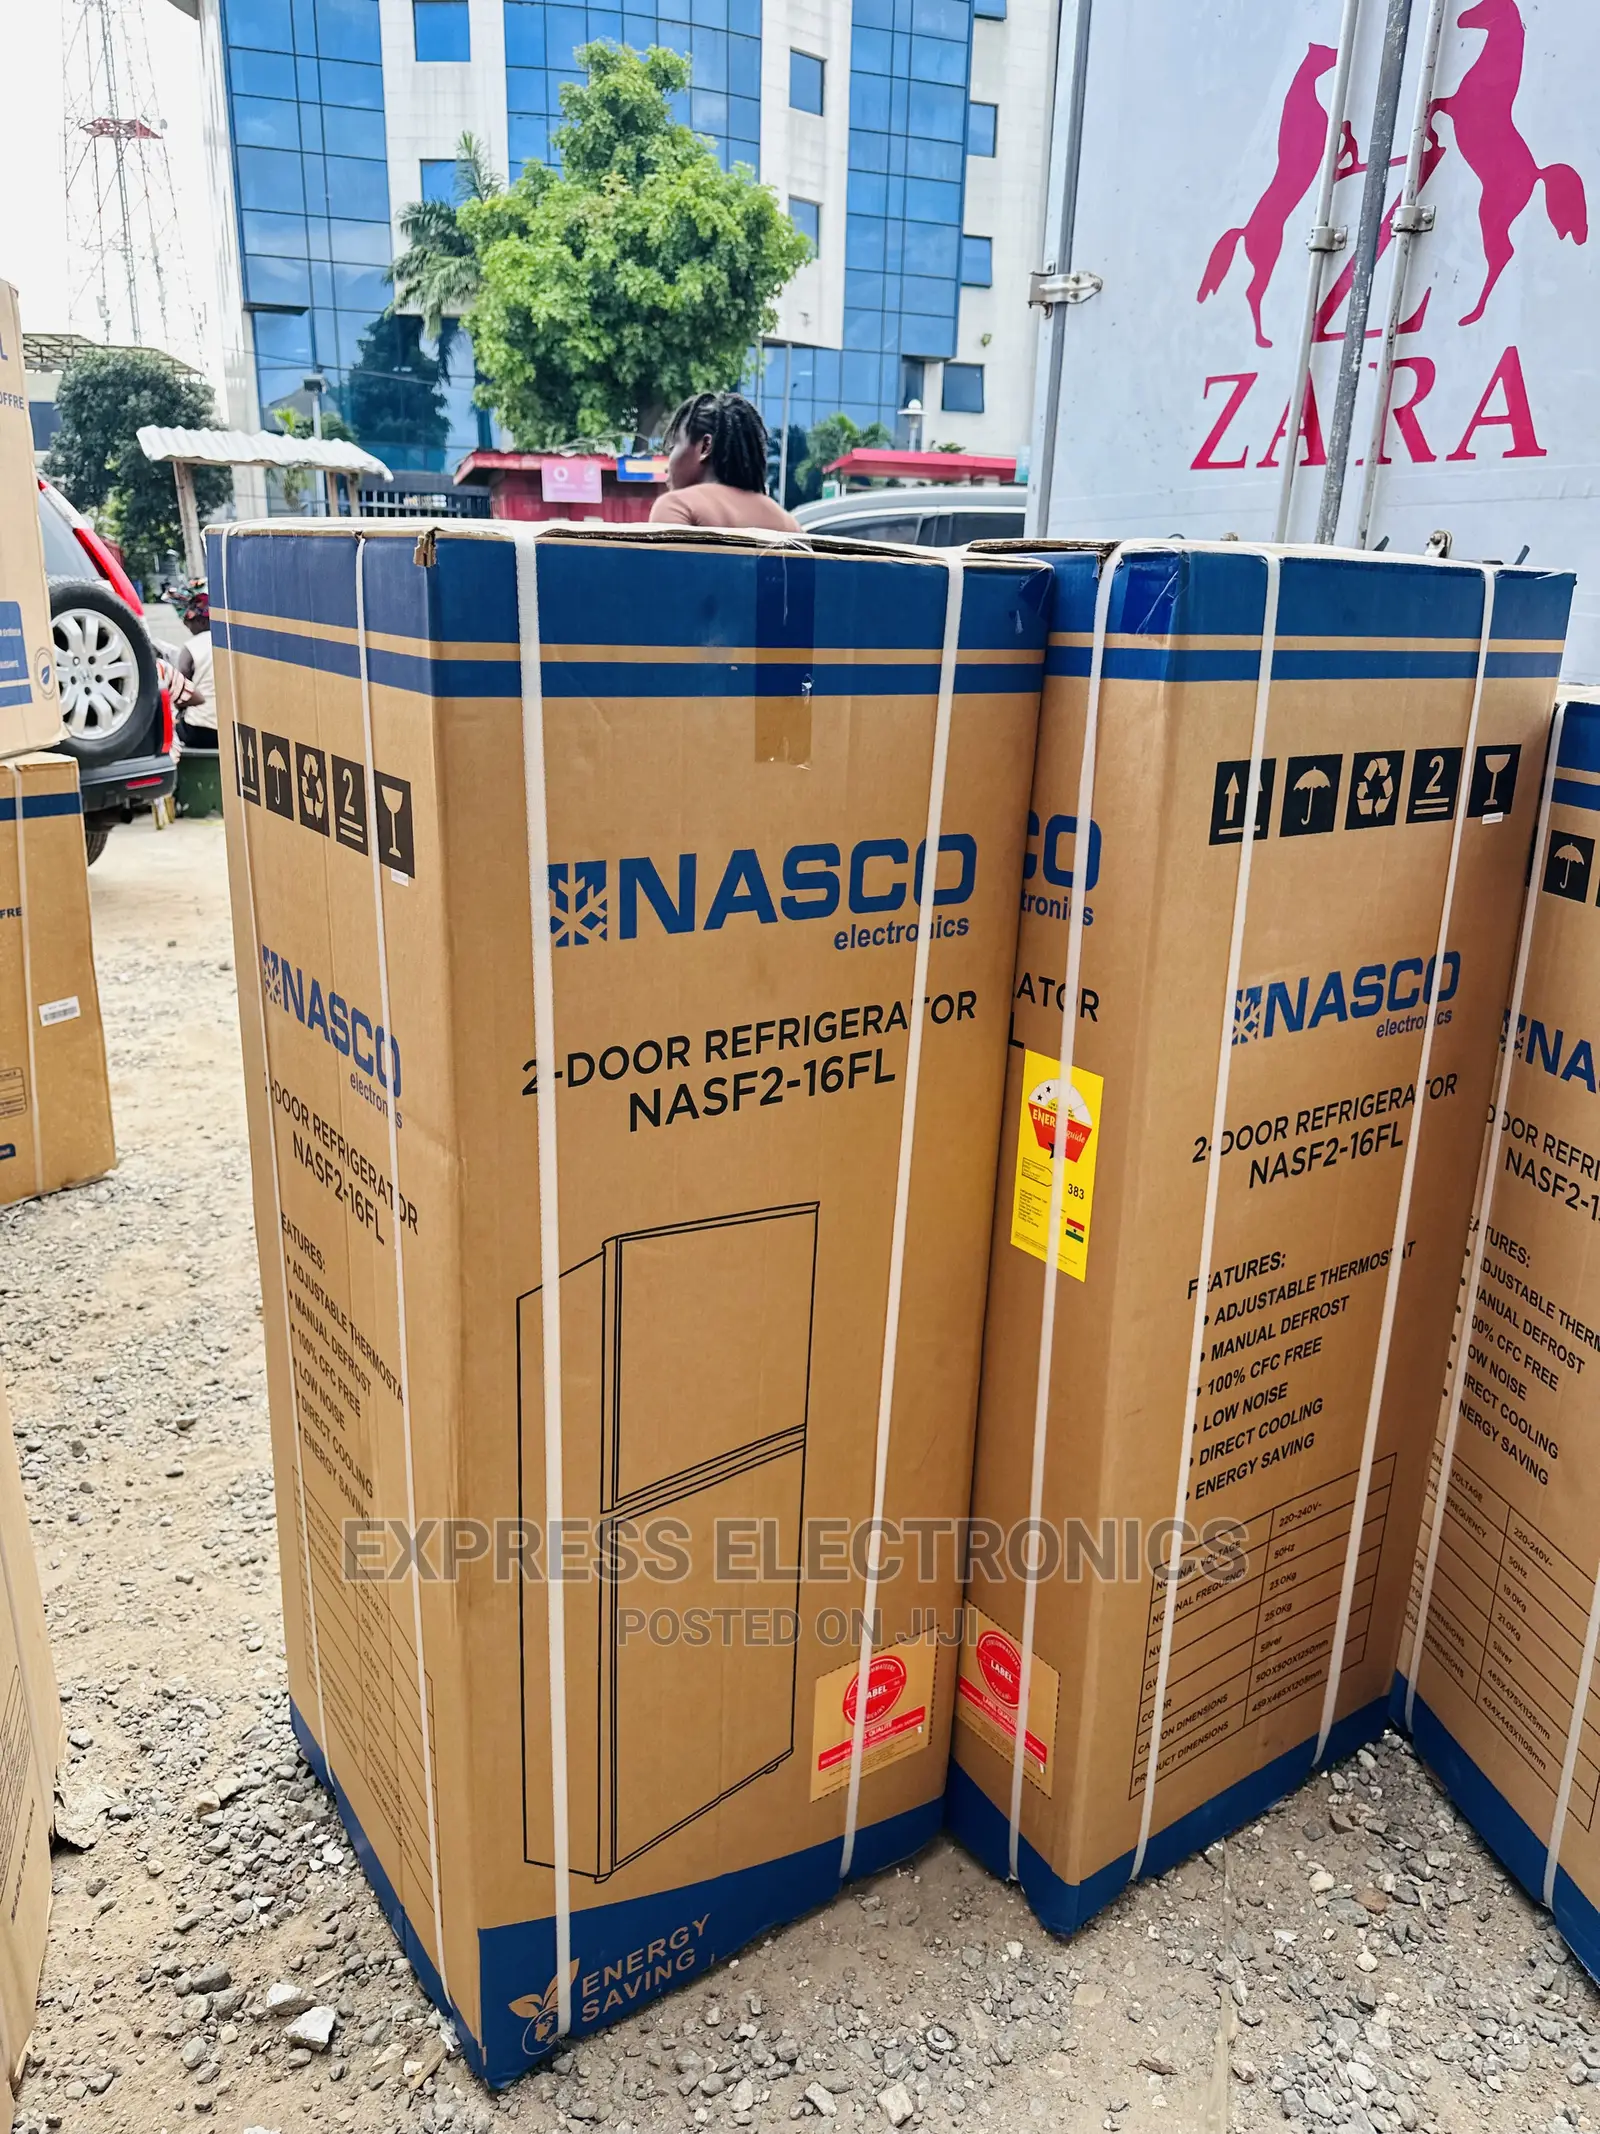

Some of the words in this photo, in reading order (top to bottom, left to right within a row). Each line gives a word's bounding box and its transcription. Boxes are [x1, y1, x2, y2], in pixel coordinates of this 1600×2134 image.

[1190, 346, 1548, 471] ZARA
[619, 833, 978, 940] NASCO
[281, 957, 402, 1098] NASCO
[1264, 951, 1461, 1038] NASCO
[1376, 1009, 1453, 1038] electroics
[521, 1035, 691, 1096] 2-DOOR
[705, 990, 978, 1064] REFRIGERAOR
[1525, 1019, 1598, 1094] NA
[264, 1071, 310, 1130] -DOOR
[350, 1071, 403, 1130] electrons
[629, 1048, 896, 1133] NASF2-16FL
[1295, 1073, 1458, 1136] REFRIGERAOR
[293, 1130, 385, 1246] NASF2-16FL
[1249, 1121, 1403, 1189] NASF2-16FL
[1505, 1146, 1600, 1221] NASF2-1
[1067, 1183, 1085, 1200] 383
[280, 1211, 327, 1274] EATURES:
[1187, 1251, 1287, 1300] FATURES:
[1214, 1274, 1316, 1326] ADJUSTABLE
[1320, 1241, 1417, 1288] THERMOST
[1480, 1257, 1555, 1319] DJUSTABLE
[292, 1259, 348, 1334] ADJUSTABLE
[349, 1321, 404, 1407] THERMOSTA
[295, 1292, 330, 1348] MANUAL
[332, 1335, 372, 1398] DEFROST
[1210, 1323, 1276, 1361] MANUAL
[1280, 1295, 1350, 1335] DEFROST
[1472, 1315, 1494, 1342] 00%
[1497, 1334, 1522, 1362] CFC
[1524, 1354, 1559, 1391] FREE
[1476, 1285, 1519, 1329] ANUAL
[1522, 1319, 1585, 1374] DEFROST
[297, 1329, 318, 1366] 100%
[319, 1353, 336, 1387] CFC
[338, 1376, 361, 1418] FREE
[299, 1361, 318, 1397] LOW
[320, 1387, 346, 1432] NOISE
[1207, 1367, 1246, 1396] 100%
[1250, 1353, 1281, 1379] CFC
[1284, 1336, 1323, 1366] FREE
[1468, 1344, 1488, 1368] OW
[1490, 1361, 1527, 1401] NOISE
[1199, 1427, 1256, 1467] DIRECT
[1258, 1397, 1324, 1440] COOLING
[1203, 1402, 1239, 1433] LOW
[1242, 1382, 1289, 1416] NOISE
[1464, 1372, 1498, 1409] IRECT
[1500, 1403, 1558, 1459] COOLING
[301, 1395, 332, 1443] DIRECT
[333, 1435, 374, 1499] COOLING
[1195, 1456, 1258, 1500] ENERGY
[1261, 1432, 1315, 1469] SAVING
[1459, 1400, 1499, 1442] NERGY
[1501, 1437, 1548, 1485] SAVING
[304, 1429, 337, 1482] ENERGY
[339, 1475, 371, 1530] SAVING
[1451, 1469, 1483, 1503] VOLTAGE
[1446, 1495, 1486, 1538] FREQUENCY
[1195, 1568, 1246, 1602] FREQUENCY
[1200, 1540, 1241, 1567] VOLTAGE
[990, 1659, 1014, 1684] LABEL
[1260, 1636, 1282, 1653] Silver
[1492, 1641, 1513, 1665] Silver
[866, 1685, 888, 1699] ABEL
[1137, 1727, 1175, 1755] CAON
[1176, 1693, 1229, 1732] DIMENSIONS
[1177, 1720, 1229, 1759] DIMENSIONS
[582, 1913, 711, 1998] ENERGY
[582, 1948, 696, 2023] SAVING
